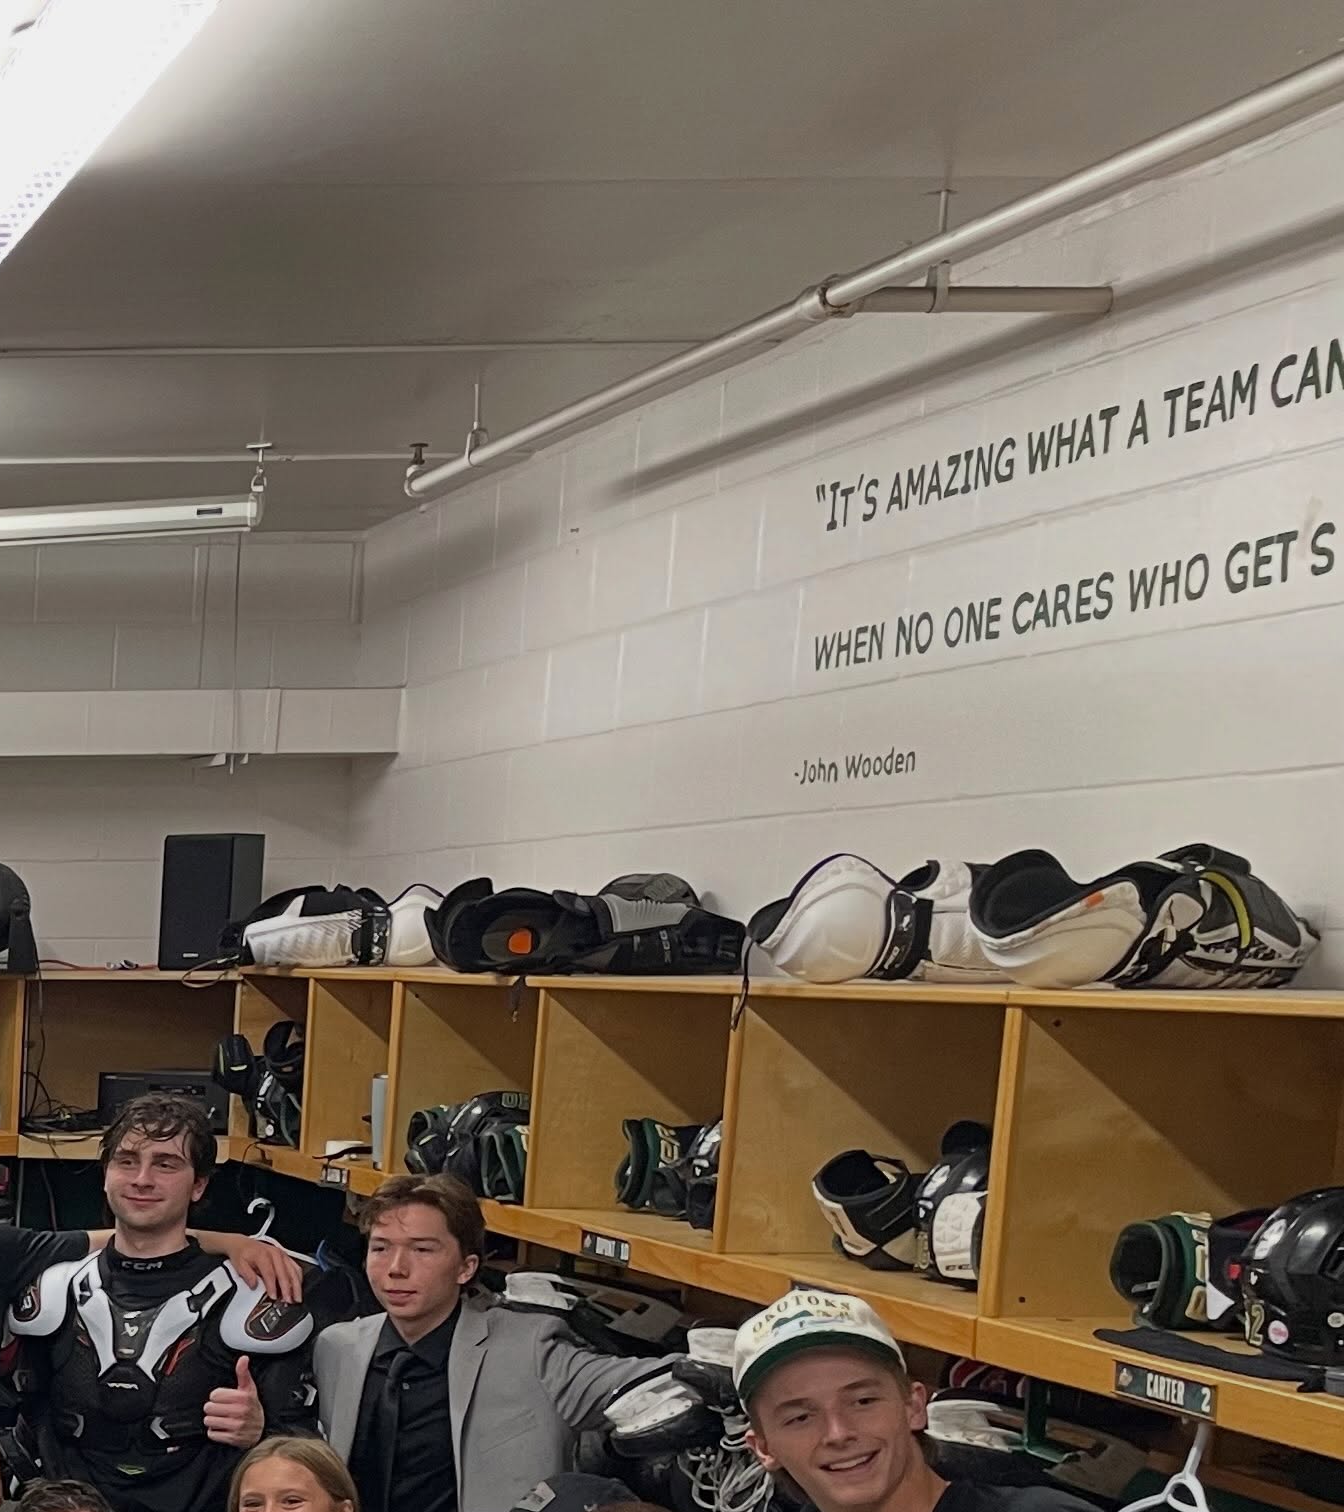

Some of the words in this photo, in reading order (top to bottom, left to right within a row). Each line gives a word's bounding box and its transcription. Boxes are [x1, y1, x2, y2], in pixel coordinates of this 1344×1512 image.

[886, 438, 1016, 514] AMAZING
[1027, 406, 1119, 474] WHAT
[1127, 400, 1149, 449] A
[1164, 363, 1260, 438] TEAM
[814, 622, 884, 671] WHEN
[895, 611, 933, 657] NO
[944, 597, 1002, 648] ONE
[1012, 571, 1114, 635] CARES
[1128, 553, 1209, 612] WHO
[794, 757, 838, 785] -John
[845, 747, 916, 778] Wooden
[1146, 1373, 1186, 1406] CARTER
[1201, 1387, 1211, 1413] 2
